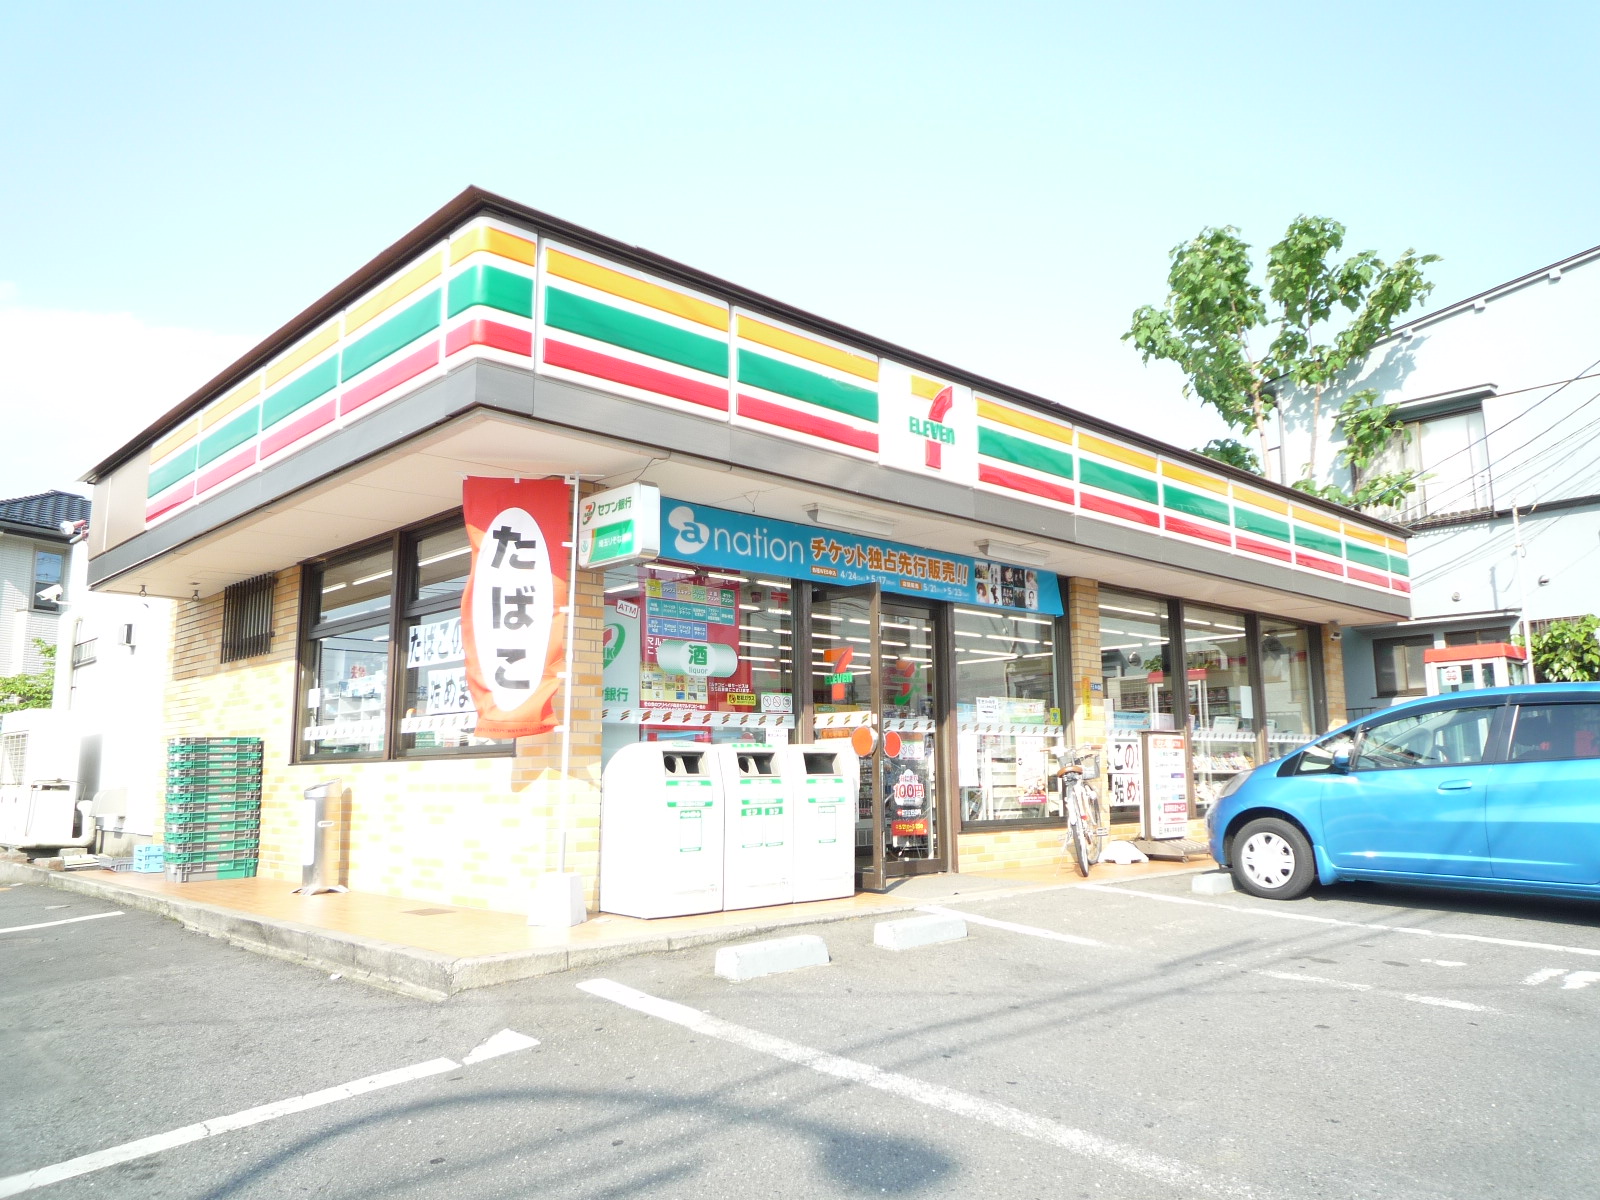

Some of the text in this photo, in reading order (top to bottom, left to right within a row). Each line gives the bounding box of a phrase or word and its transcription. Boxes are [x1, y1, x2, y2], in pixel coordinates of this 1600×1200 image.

[598, 496, 632, 516] セブン銀行
[598, 532, 632, 548] 埼玉りそな
[714, 527, 804, 565] nation
[490, 525, 537, 691] たばこ
[618, 603, 637, 615] ATM
[688, 644, 708, 666] 酒
[688, 666, 708, 674] liquor
[893, 783, 925, 799] 100円
